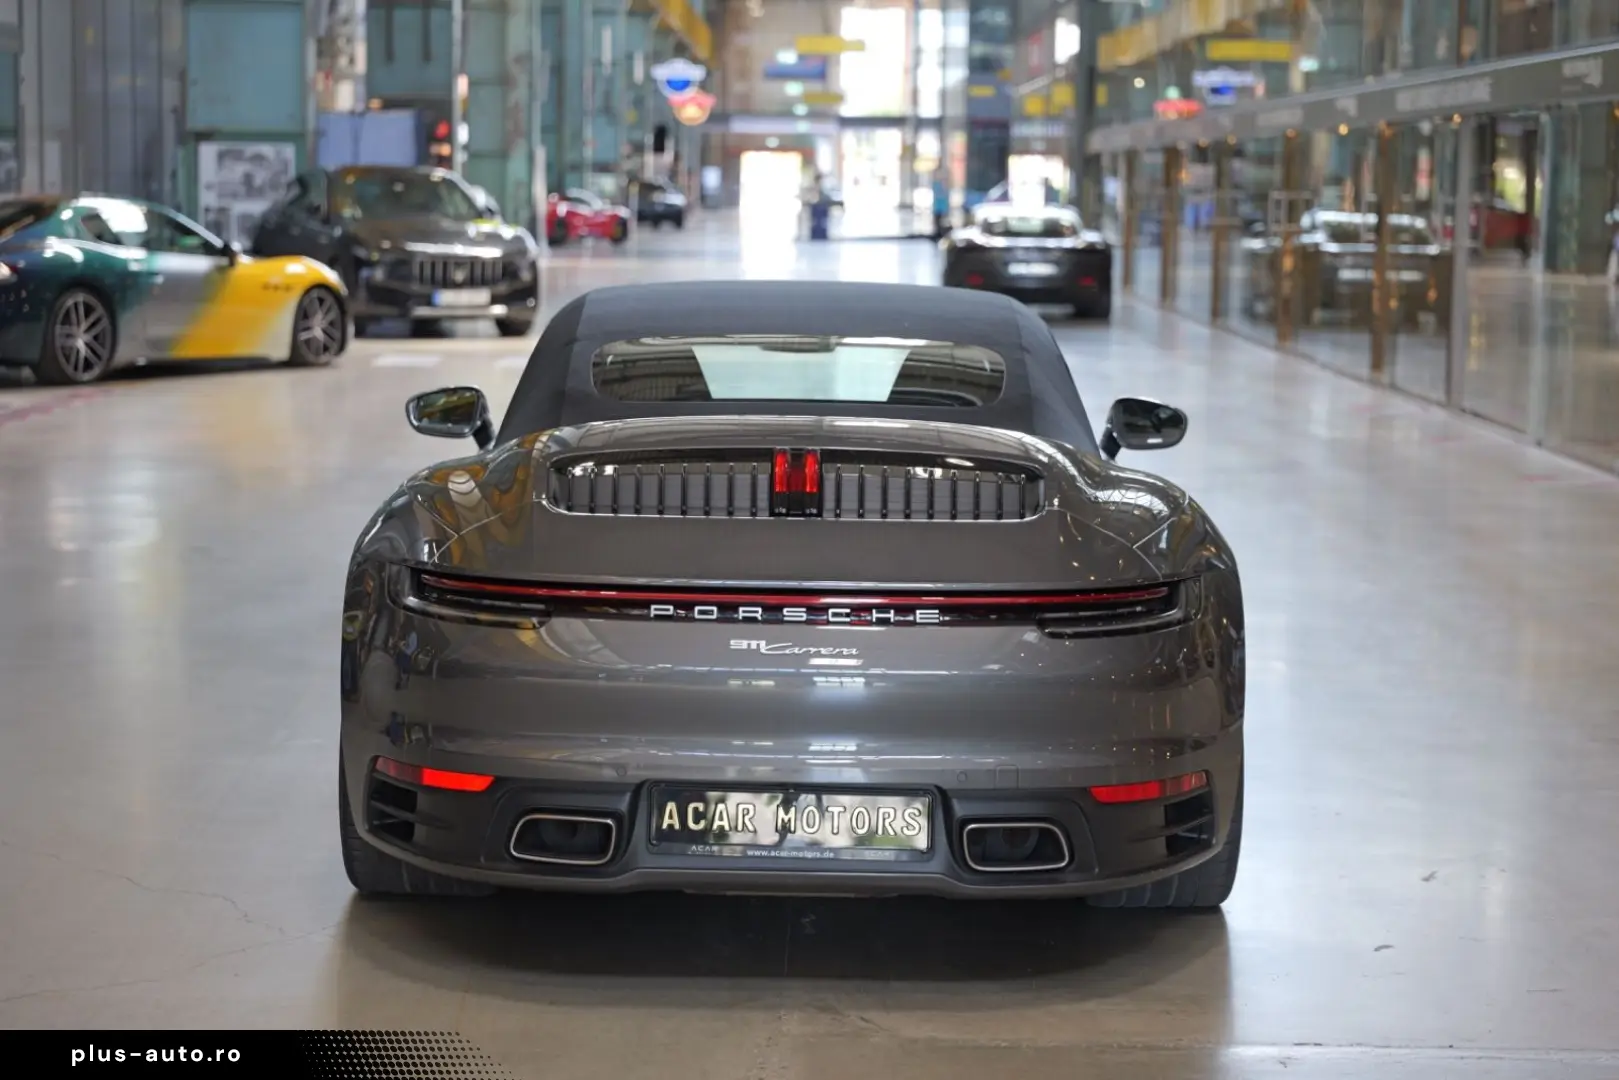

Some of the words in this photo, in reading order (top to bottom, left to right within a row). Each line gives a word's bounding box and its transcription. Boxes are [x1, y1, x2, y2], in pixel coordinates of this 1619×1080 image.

[650, 605, 940, 623] PORSCHE
[760, 642, 859, 655] Carrera
[661, 801, 756, 833] ACAR
[775, 805, 922, 836] MOTORS
